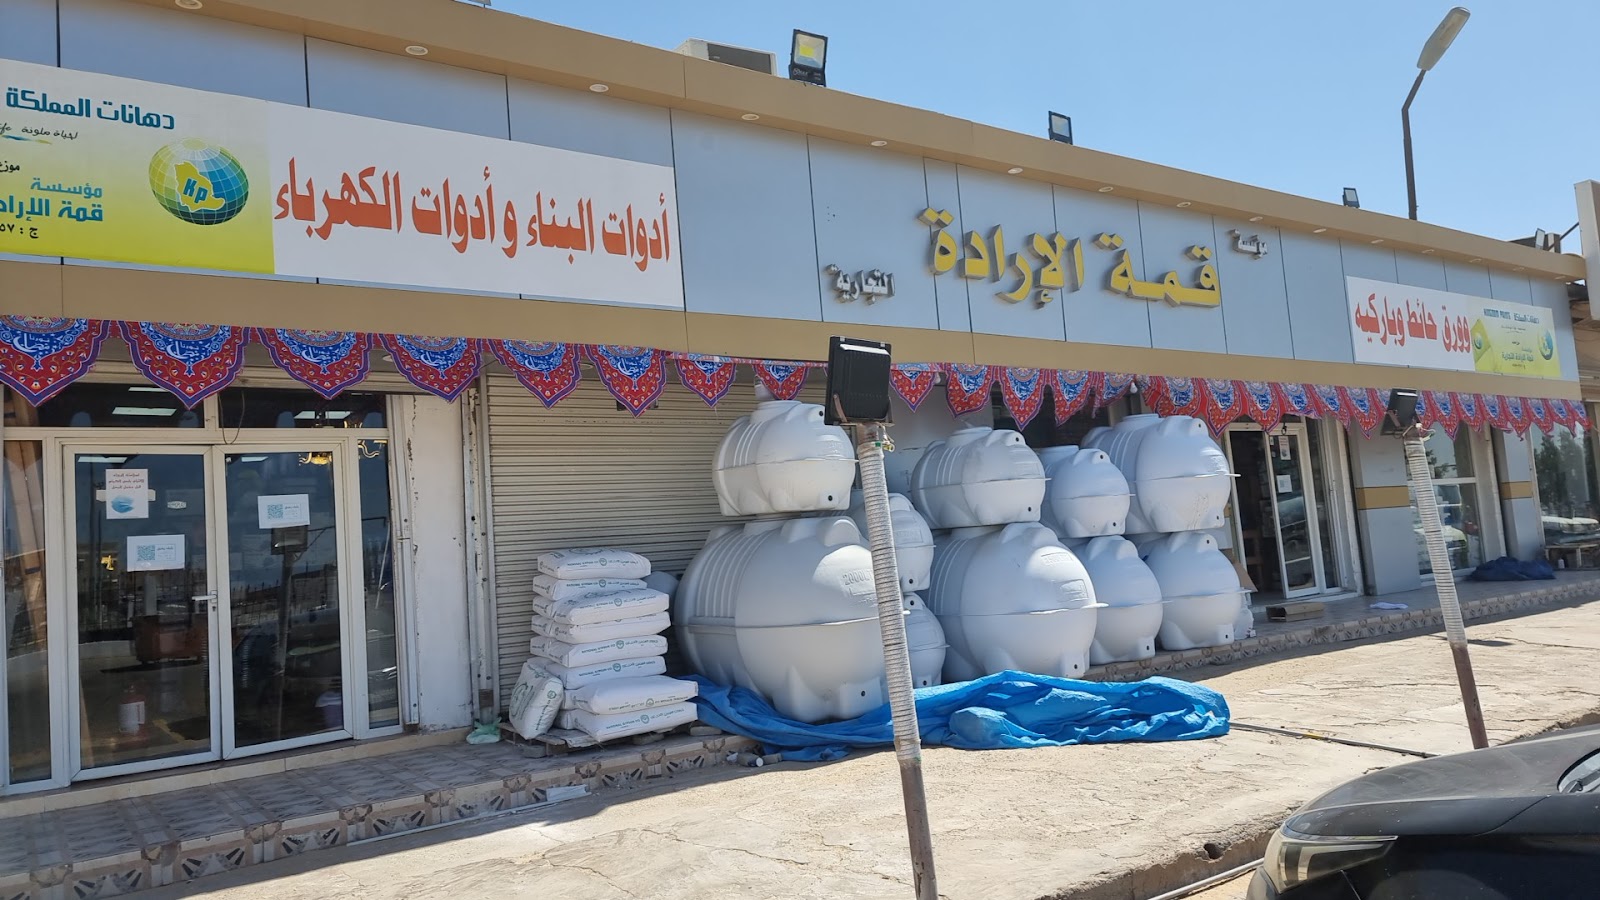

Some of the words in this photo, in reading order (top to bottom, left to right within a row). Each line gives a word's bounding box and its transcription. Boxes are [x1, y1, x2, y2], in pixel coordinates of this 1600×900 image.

[6, 86, 91, 118] المملكة
[97, 101, 174, 129] دهانات
[0, 195, 50, 221] الإراد
[30, 177, 103, 199] مؤسسة
[274, 156, 401, 241] الكهرباء
[411, 165, 496, 254] أدوات
[57, 200, 104, 222] قمة
[526, 191, 595, 265] البناء
[602, 192, 672, 272] أدوات
[917, 207, 1084, 308] الإرادة
[1094, 231, 1220, 307] قمة
[825, 263, 896, 305] التجارية
[1406, 298, 1438, 341] حائط
